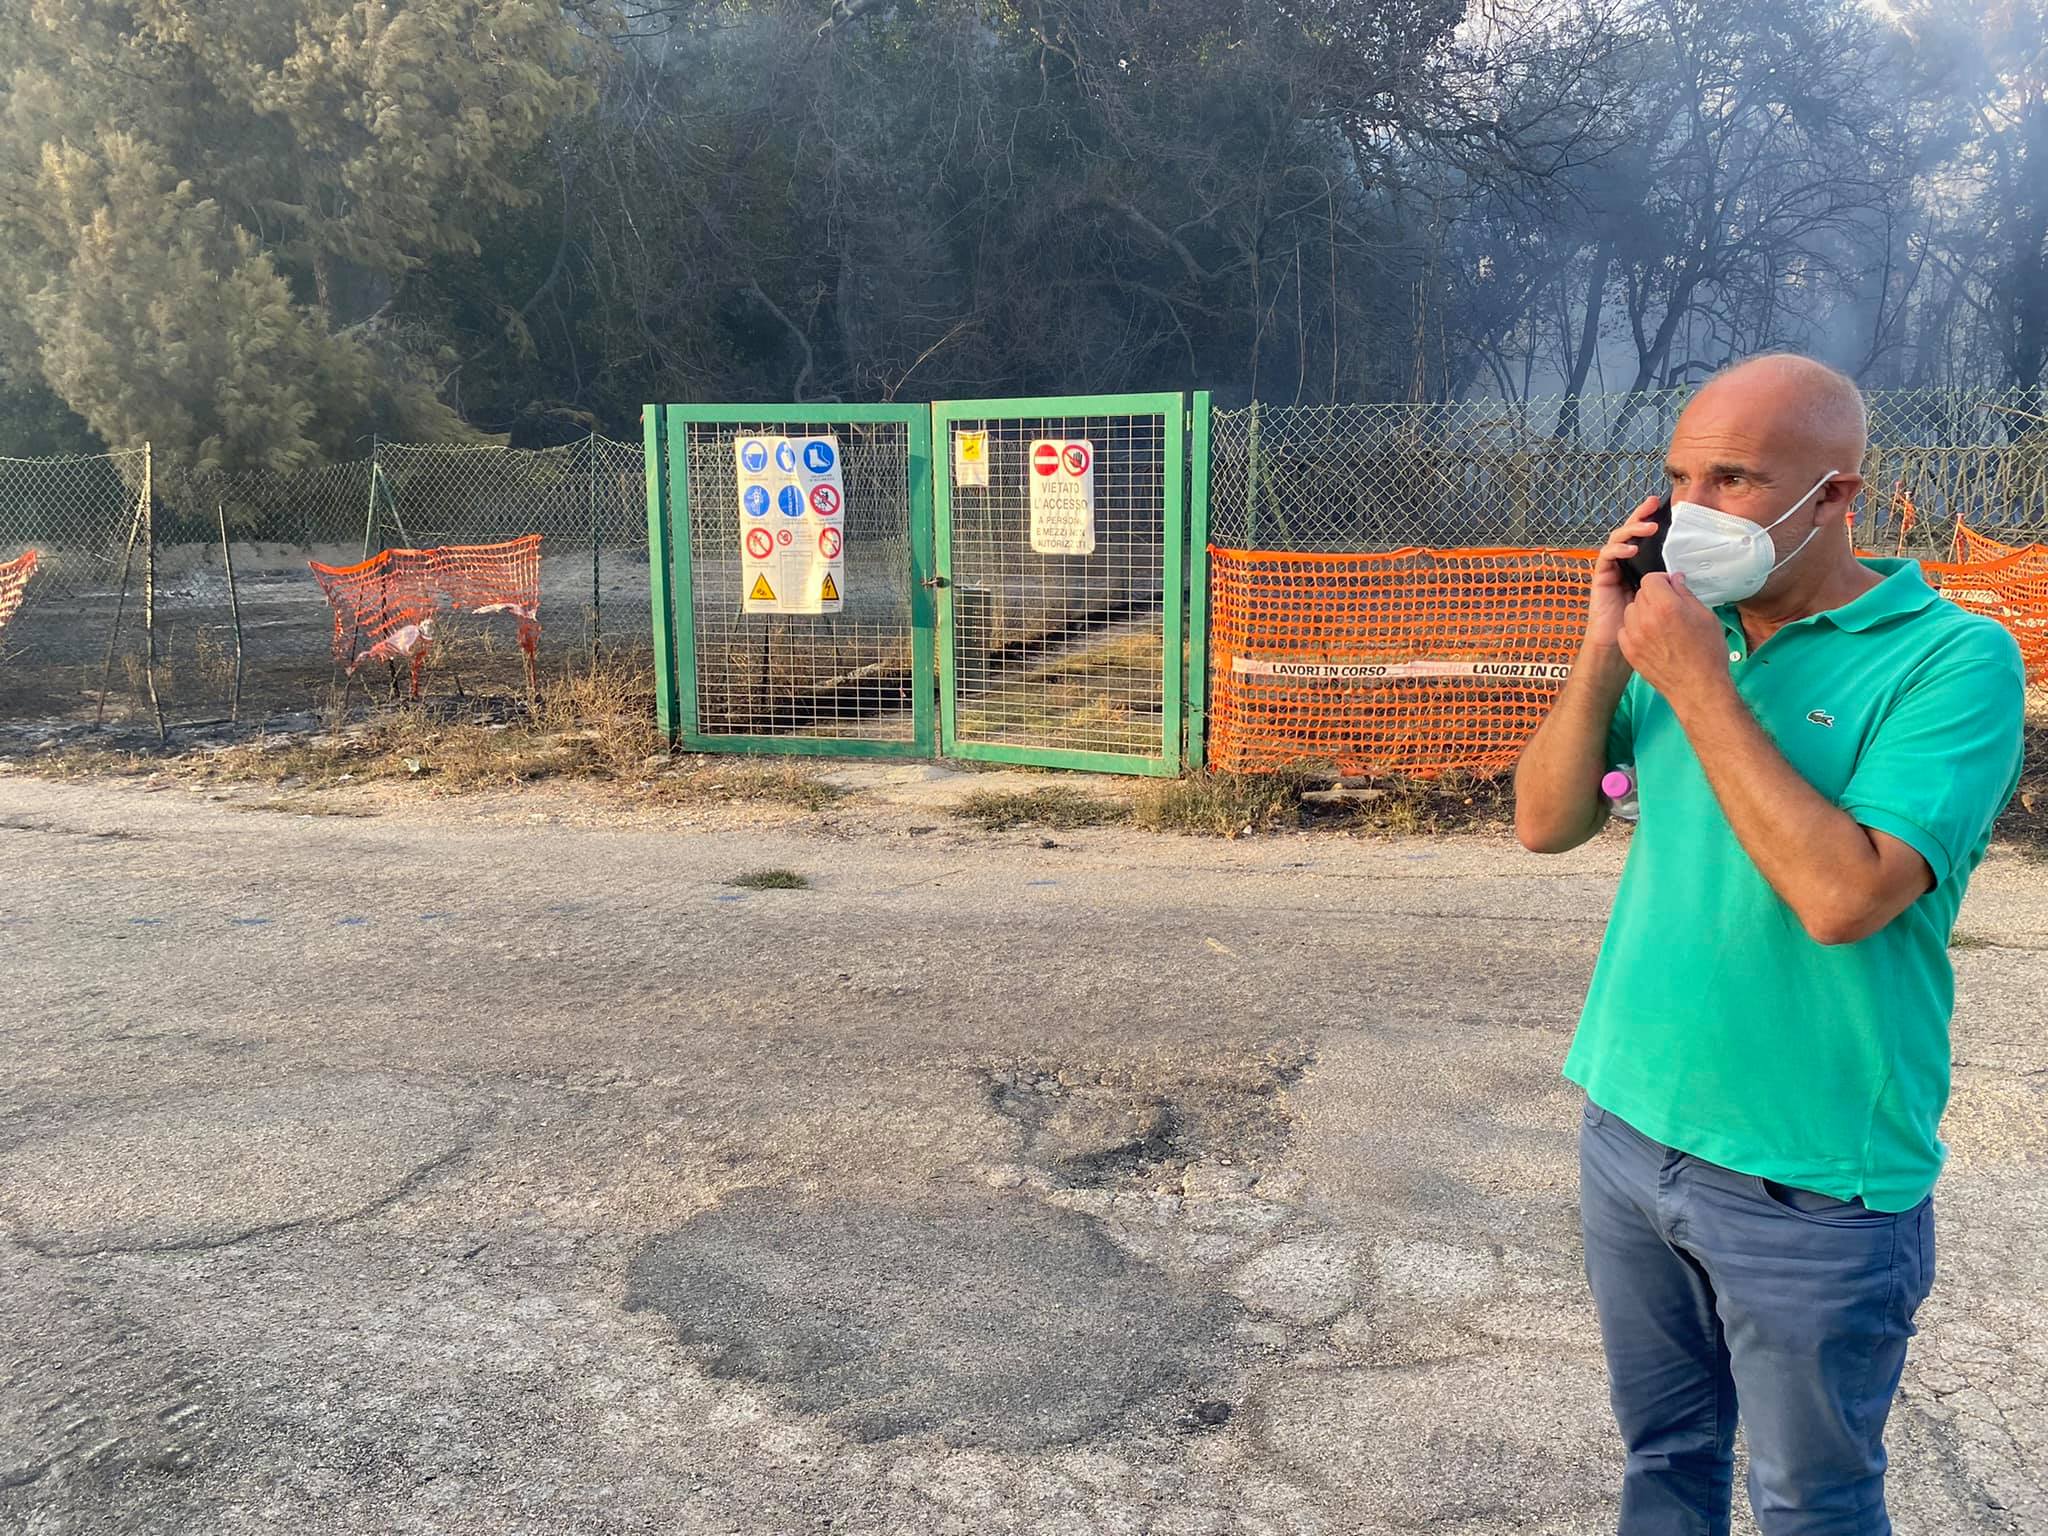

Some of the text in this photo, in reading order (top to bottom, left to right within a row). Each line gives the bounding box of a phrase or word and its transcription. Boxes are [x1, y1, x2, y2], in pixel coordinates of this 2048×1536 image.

[1041, 482, 1080, 494] VIETATO
[1034, 498, 1088, 510] L'ACCESSO
[1038, 516, 1084, 525] A PERSON
[1036, 528, 1041, 536] E
[1272, 663, 1320, 676] LAVORI
[1324, 666, 1338, 676] IN
[1341, 666, 1387, 677] CORSO
[1472, 664, 1527, 676] LAVORI
[1528, 665, 1547, 677] IN
